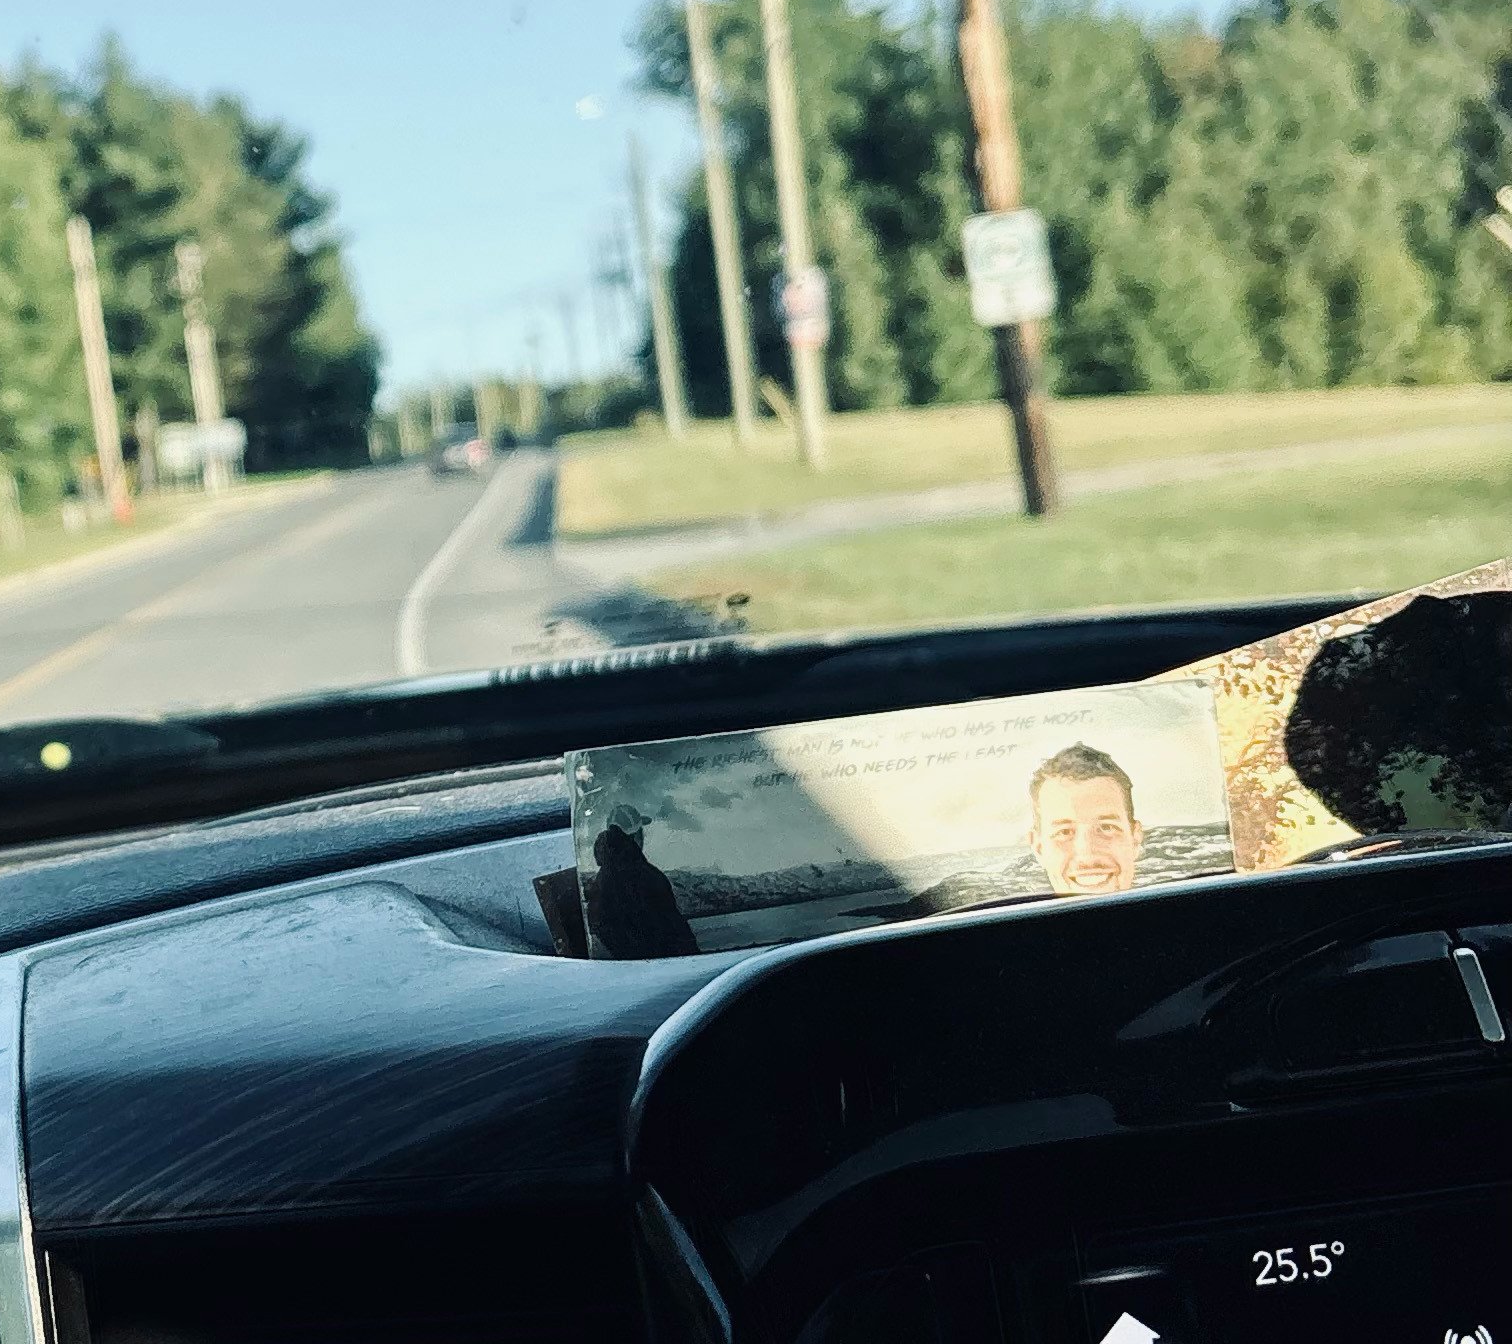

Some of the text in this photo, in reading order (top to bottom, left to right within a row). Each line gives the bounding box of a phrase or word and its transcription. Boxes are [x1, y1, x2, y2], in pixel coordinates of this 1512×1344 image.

[788, 740, 822, 757] MAN
[829, 738, 844, 755] IS
[921, 725, 957, 742] WHO
[963, 720, 997, 737] HAS
[1003, 715, 1037, 733] THE
[820, 762, 858, 779] WHO
[863, 755, 918, 774] NEEDS
[925, 751, 960, 767] THE
